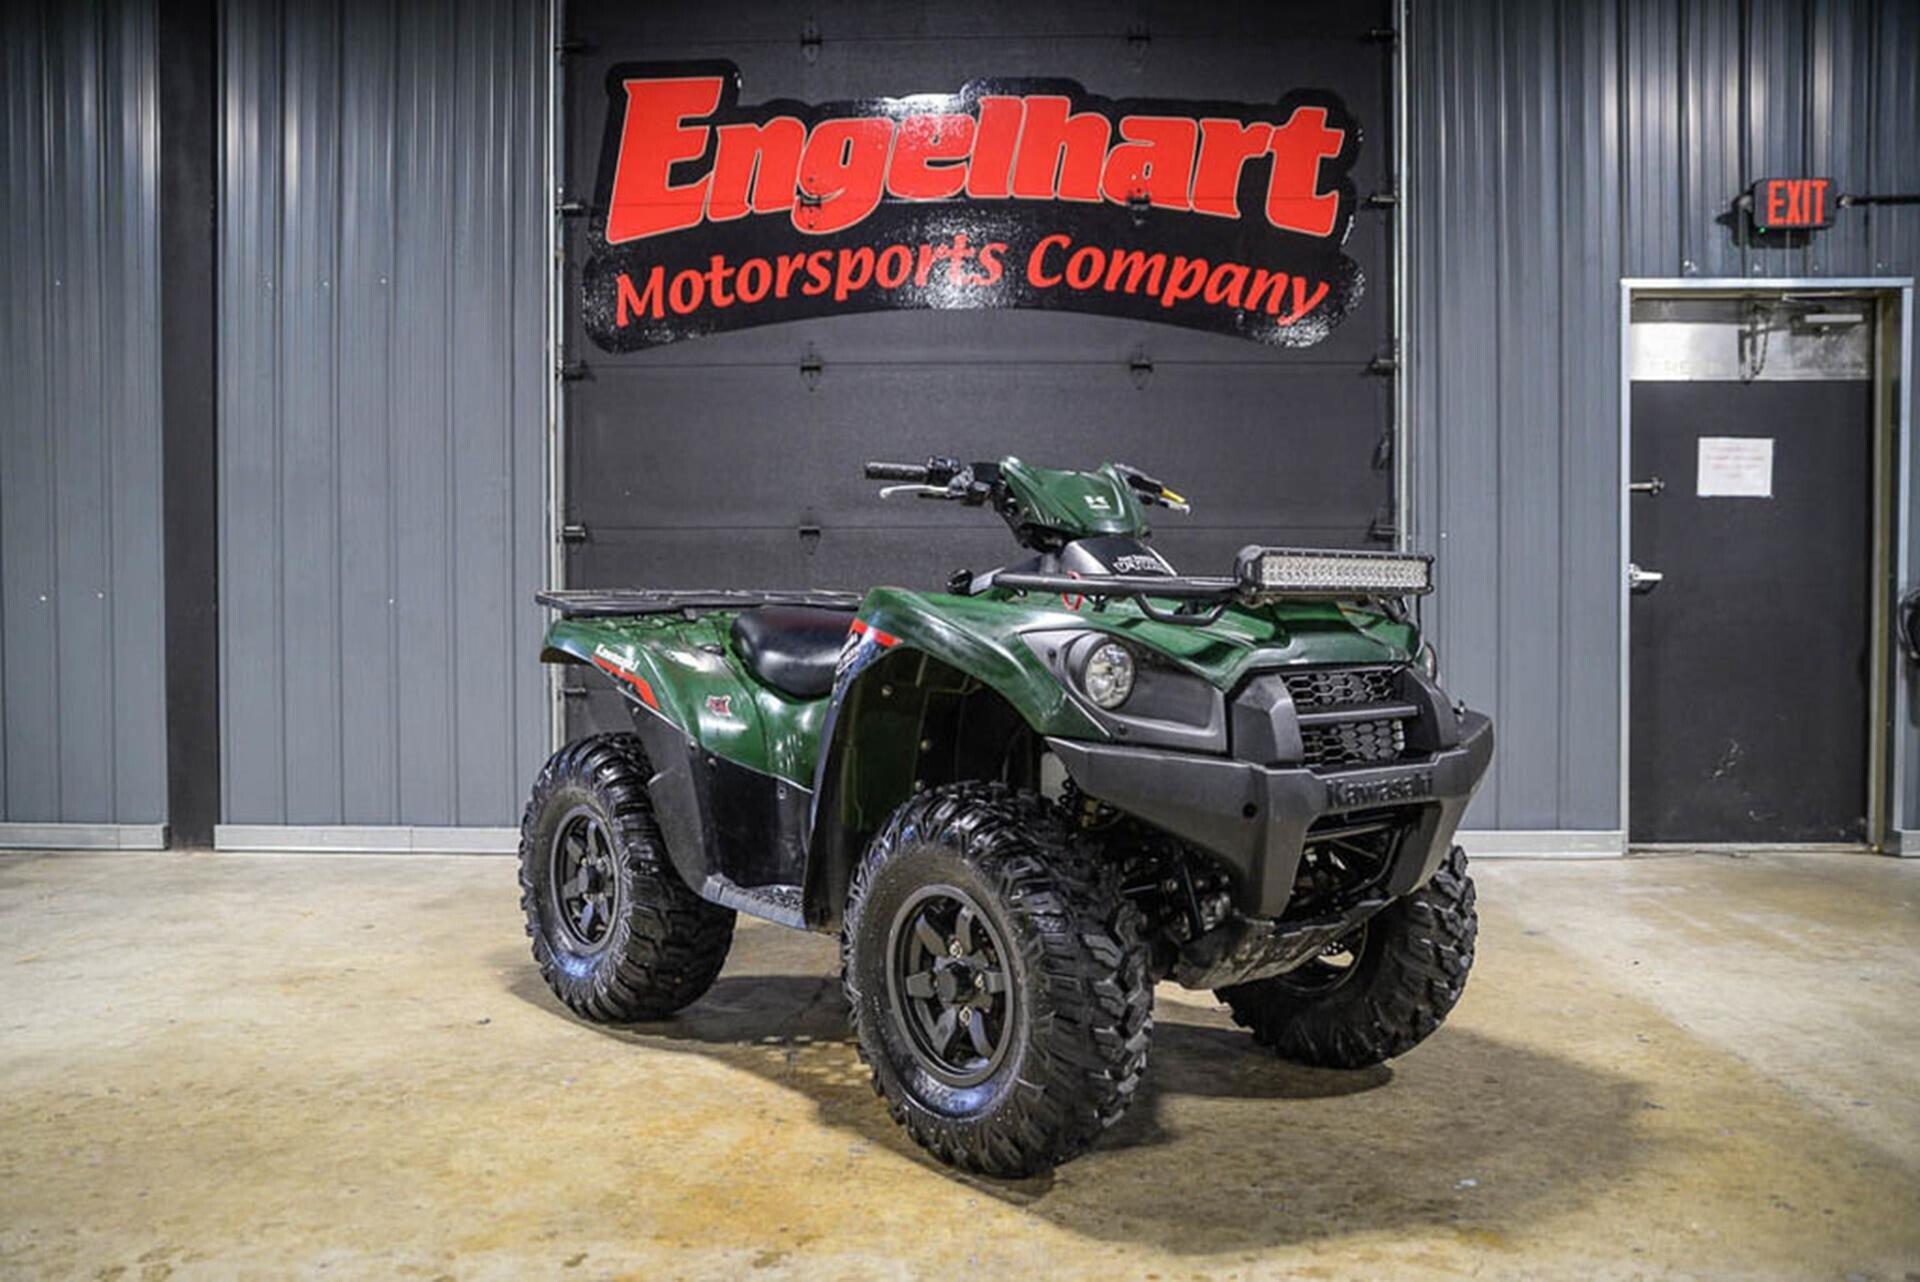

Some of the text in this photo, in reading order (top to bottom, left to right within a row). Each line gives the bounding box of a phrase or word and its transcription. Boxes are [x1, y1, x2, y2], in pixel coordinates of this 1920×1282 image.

[607, 76, 1345, 242] Engelhart
[1767, 179, 1828, 226] EXIT
[615, 233, 1330, 328] Motorsports Company
